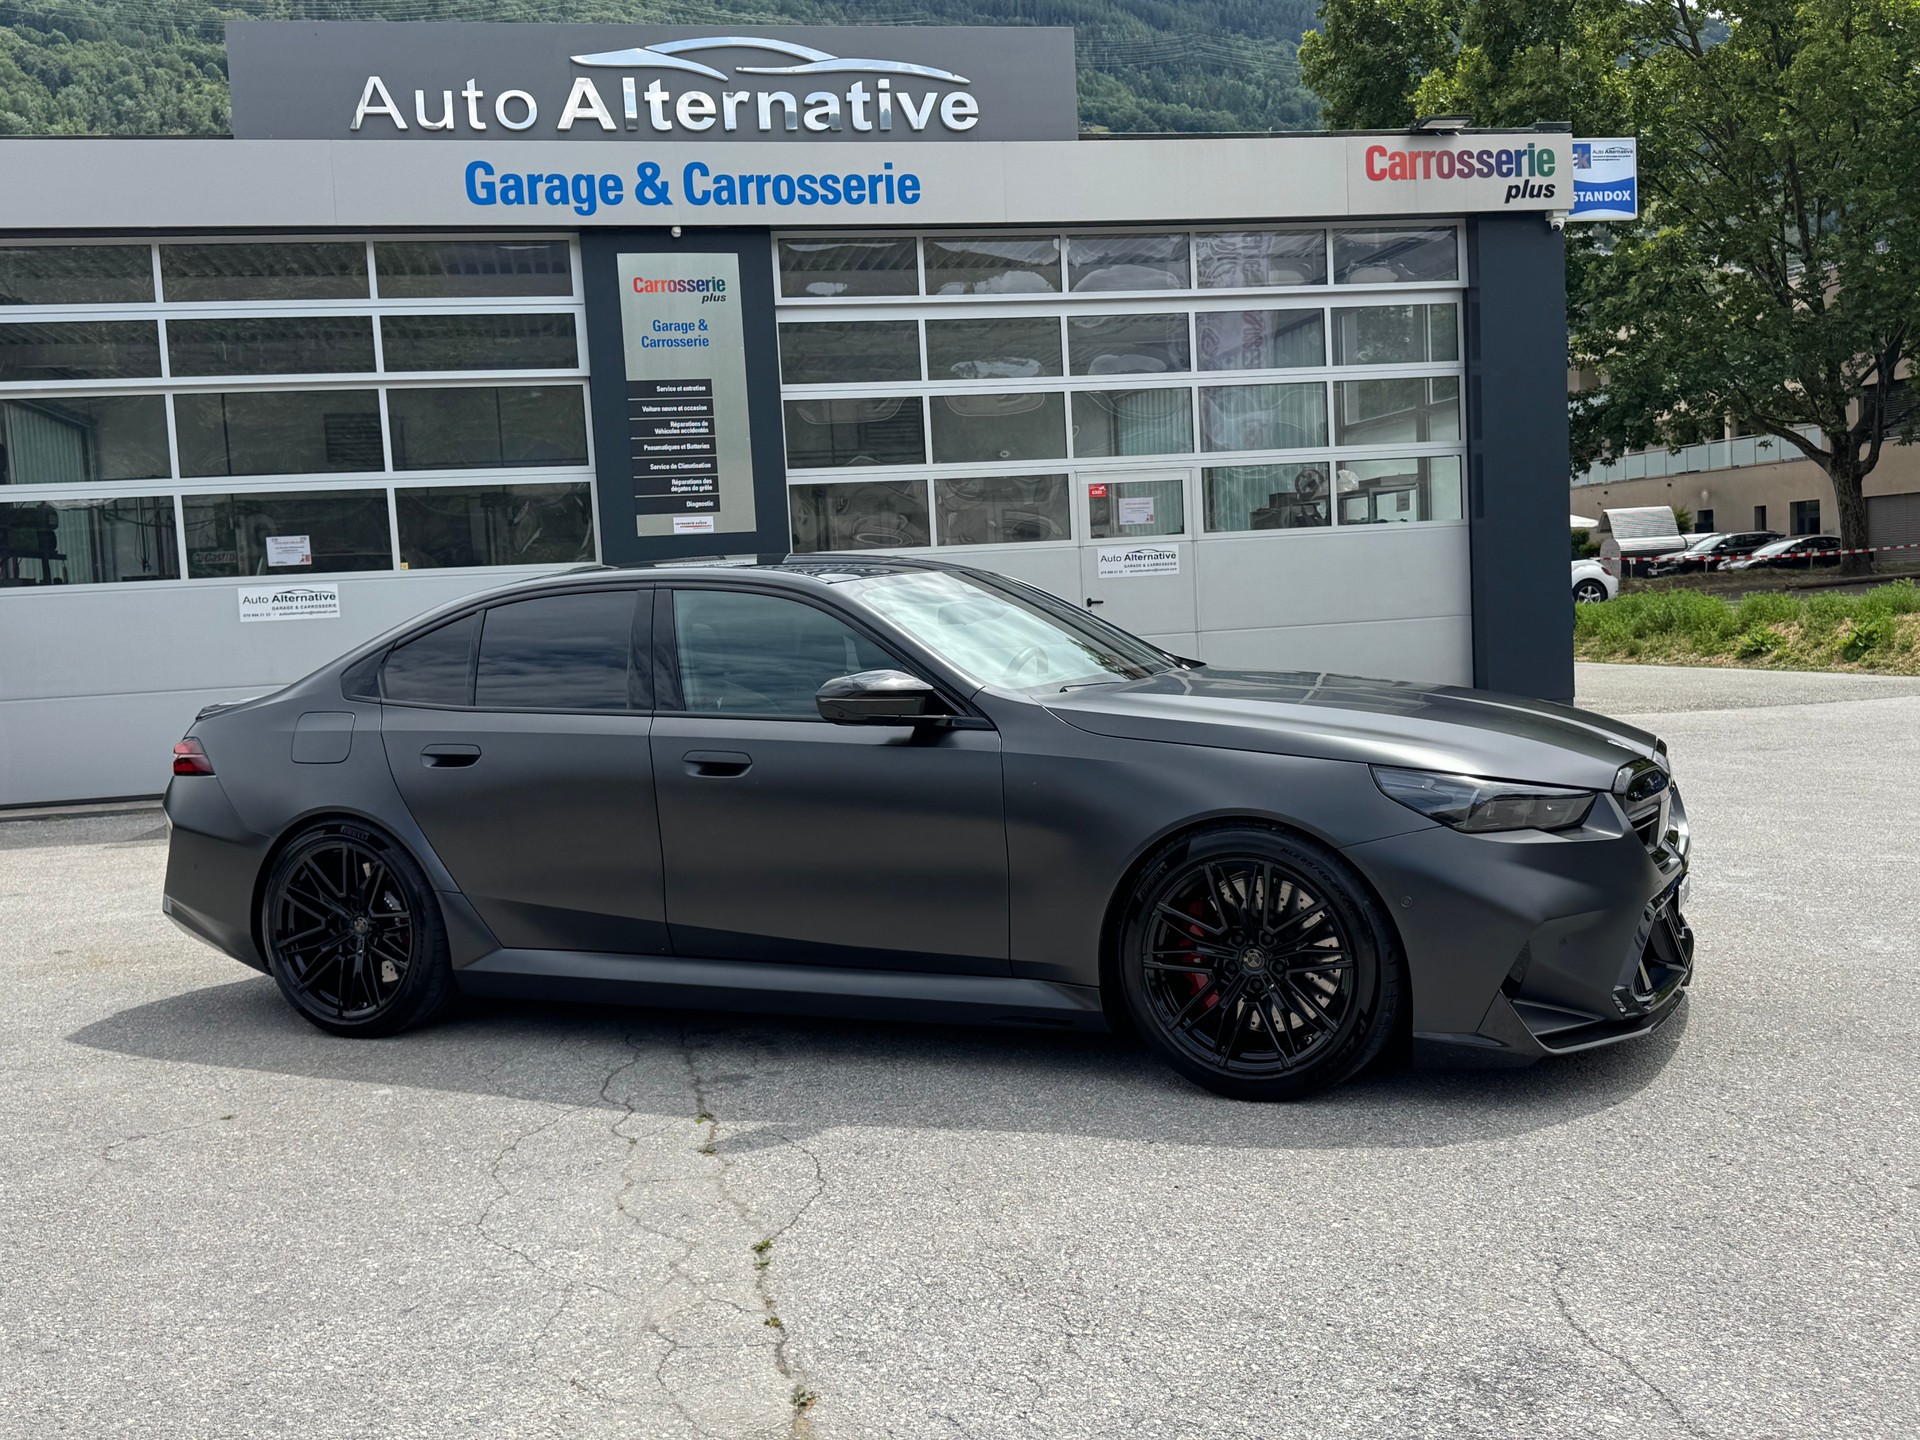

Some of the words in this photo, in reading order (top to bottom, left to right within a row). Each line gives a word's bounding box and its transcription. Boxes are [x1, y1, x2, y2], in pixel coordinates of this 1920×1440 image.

[350, 76, 539, 132] Auto
[557, 76, 980, 133] Alternative
[1365, 142, 1556, 182] Carrosserie
[465, 160, 624, 217] Garage
[635, 161, 670, 207] &
[682, 161, 922, 207] Carrosserie
[1504, 179, 1556, 204] plus
[1573, 190, 1631, 203] STANDOX
[633, 276, 726, 294] Carrosserie
[701, 293, 727, 304] plus
[652, 319, 695, 334] Garage
[697, 319, 709, 332] &
[641, 334, 710, 349] Carrosserie
[656, 385, 676, 393] Service
[683, 384, 706, 392] entretien
[642, 405, 661, 413] Voiture
[684, 404, 708, 412] occasion
[670, 420, 701, 429] Réparations
[643, 443, 680, 452] Pneumatiques
[686, 442, 710, 450] Batteries
[678, 462, 712, 470] Climatisation
[672, 478, 702, 486] Réparations
[699, 484, 713, 492] grêle
[686, 500, 714, 508] Diagnostic
[1100, 554, 1122, 563] Auto
[1124, 552, 1177, 562] Alternative
[242, 595, 269, 605] Auto
[272, 593, 336, 604] Alternative
